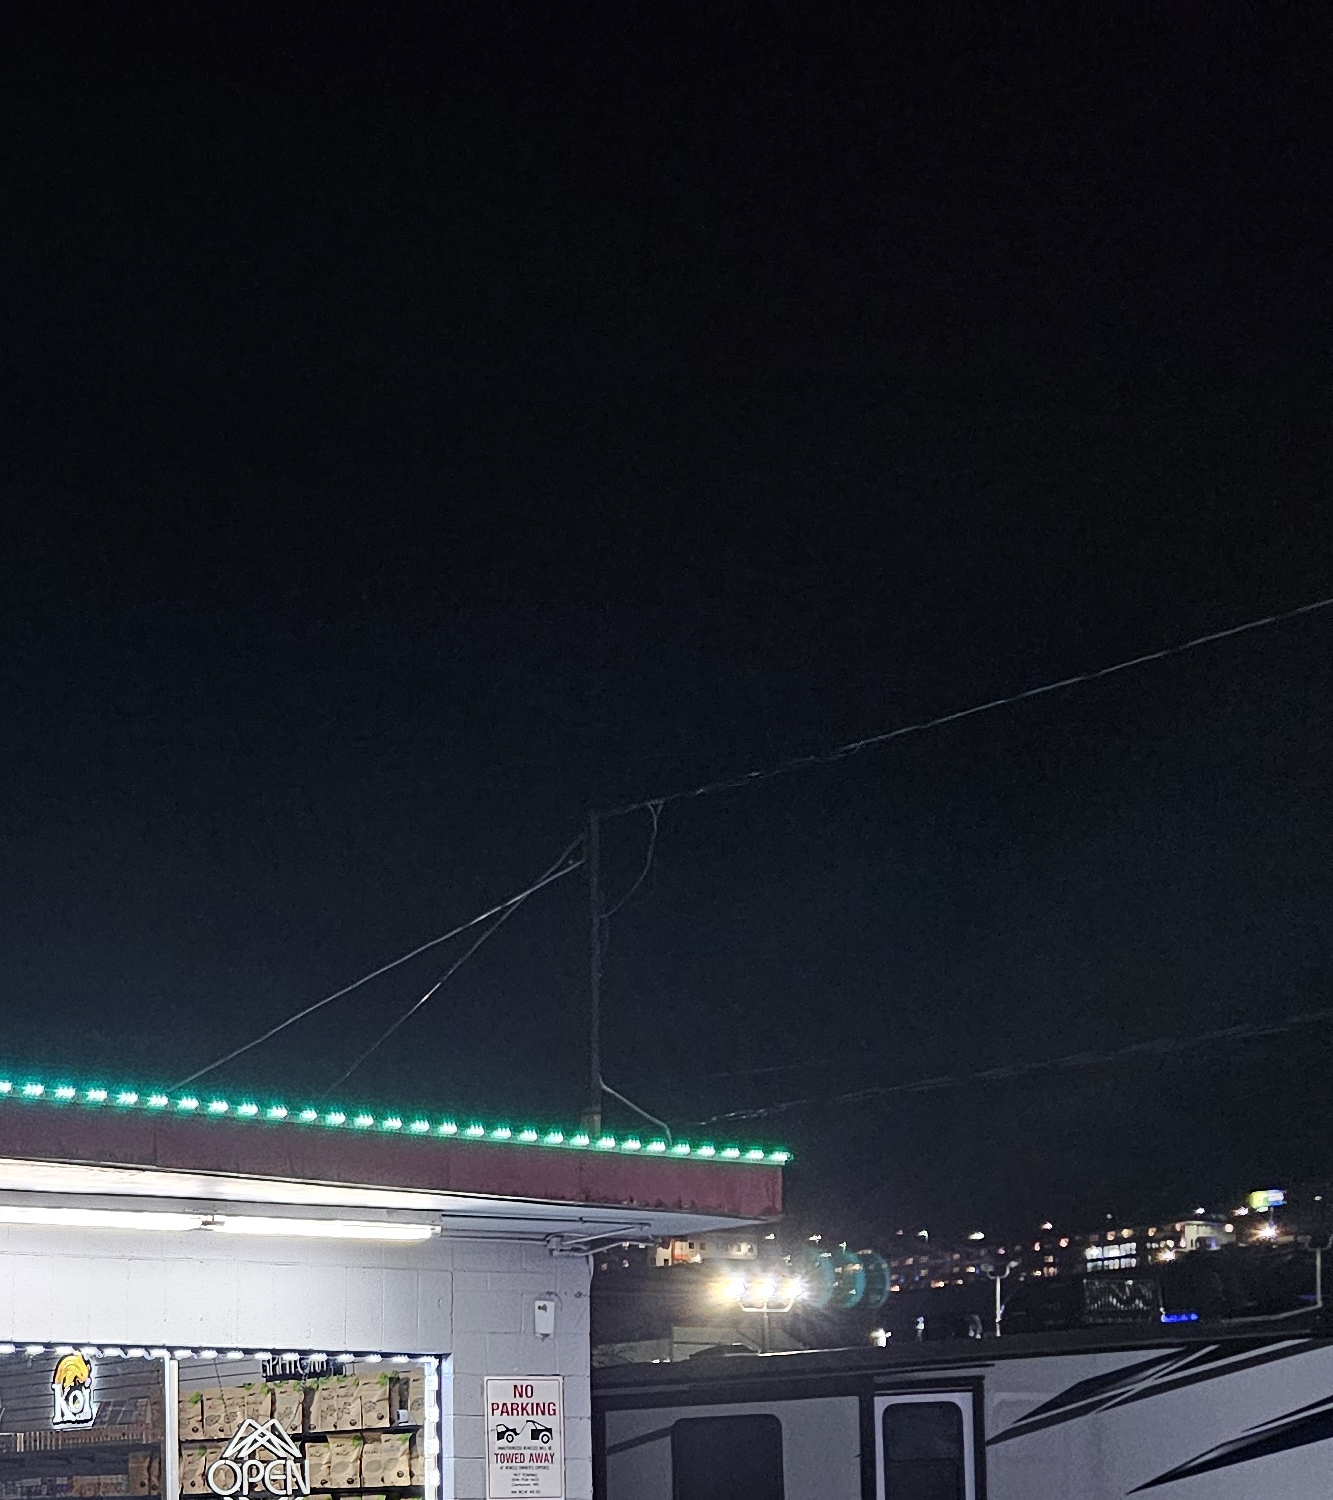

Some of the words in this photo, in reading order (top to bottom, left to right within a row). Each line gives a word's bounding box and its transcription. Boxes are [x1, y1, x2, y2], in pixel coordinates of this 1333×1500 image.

[513, 1384, 534, 1399] NO
[491, 1401, 557, 1417] PARKING
[494, 1452, 525, 1465] TOWED
[529, 1452, 555, 1465] AWAY
[206, 1459, 311, 1496] OPEN
